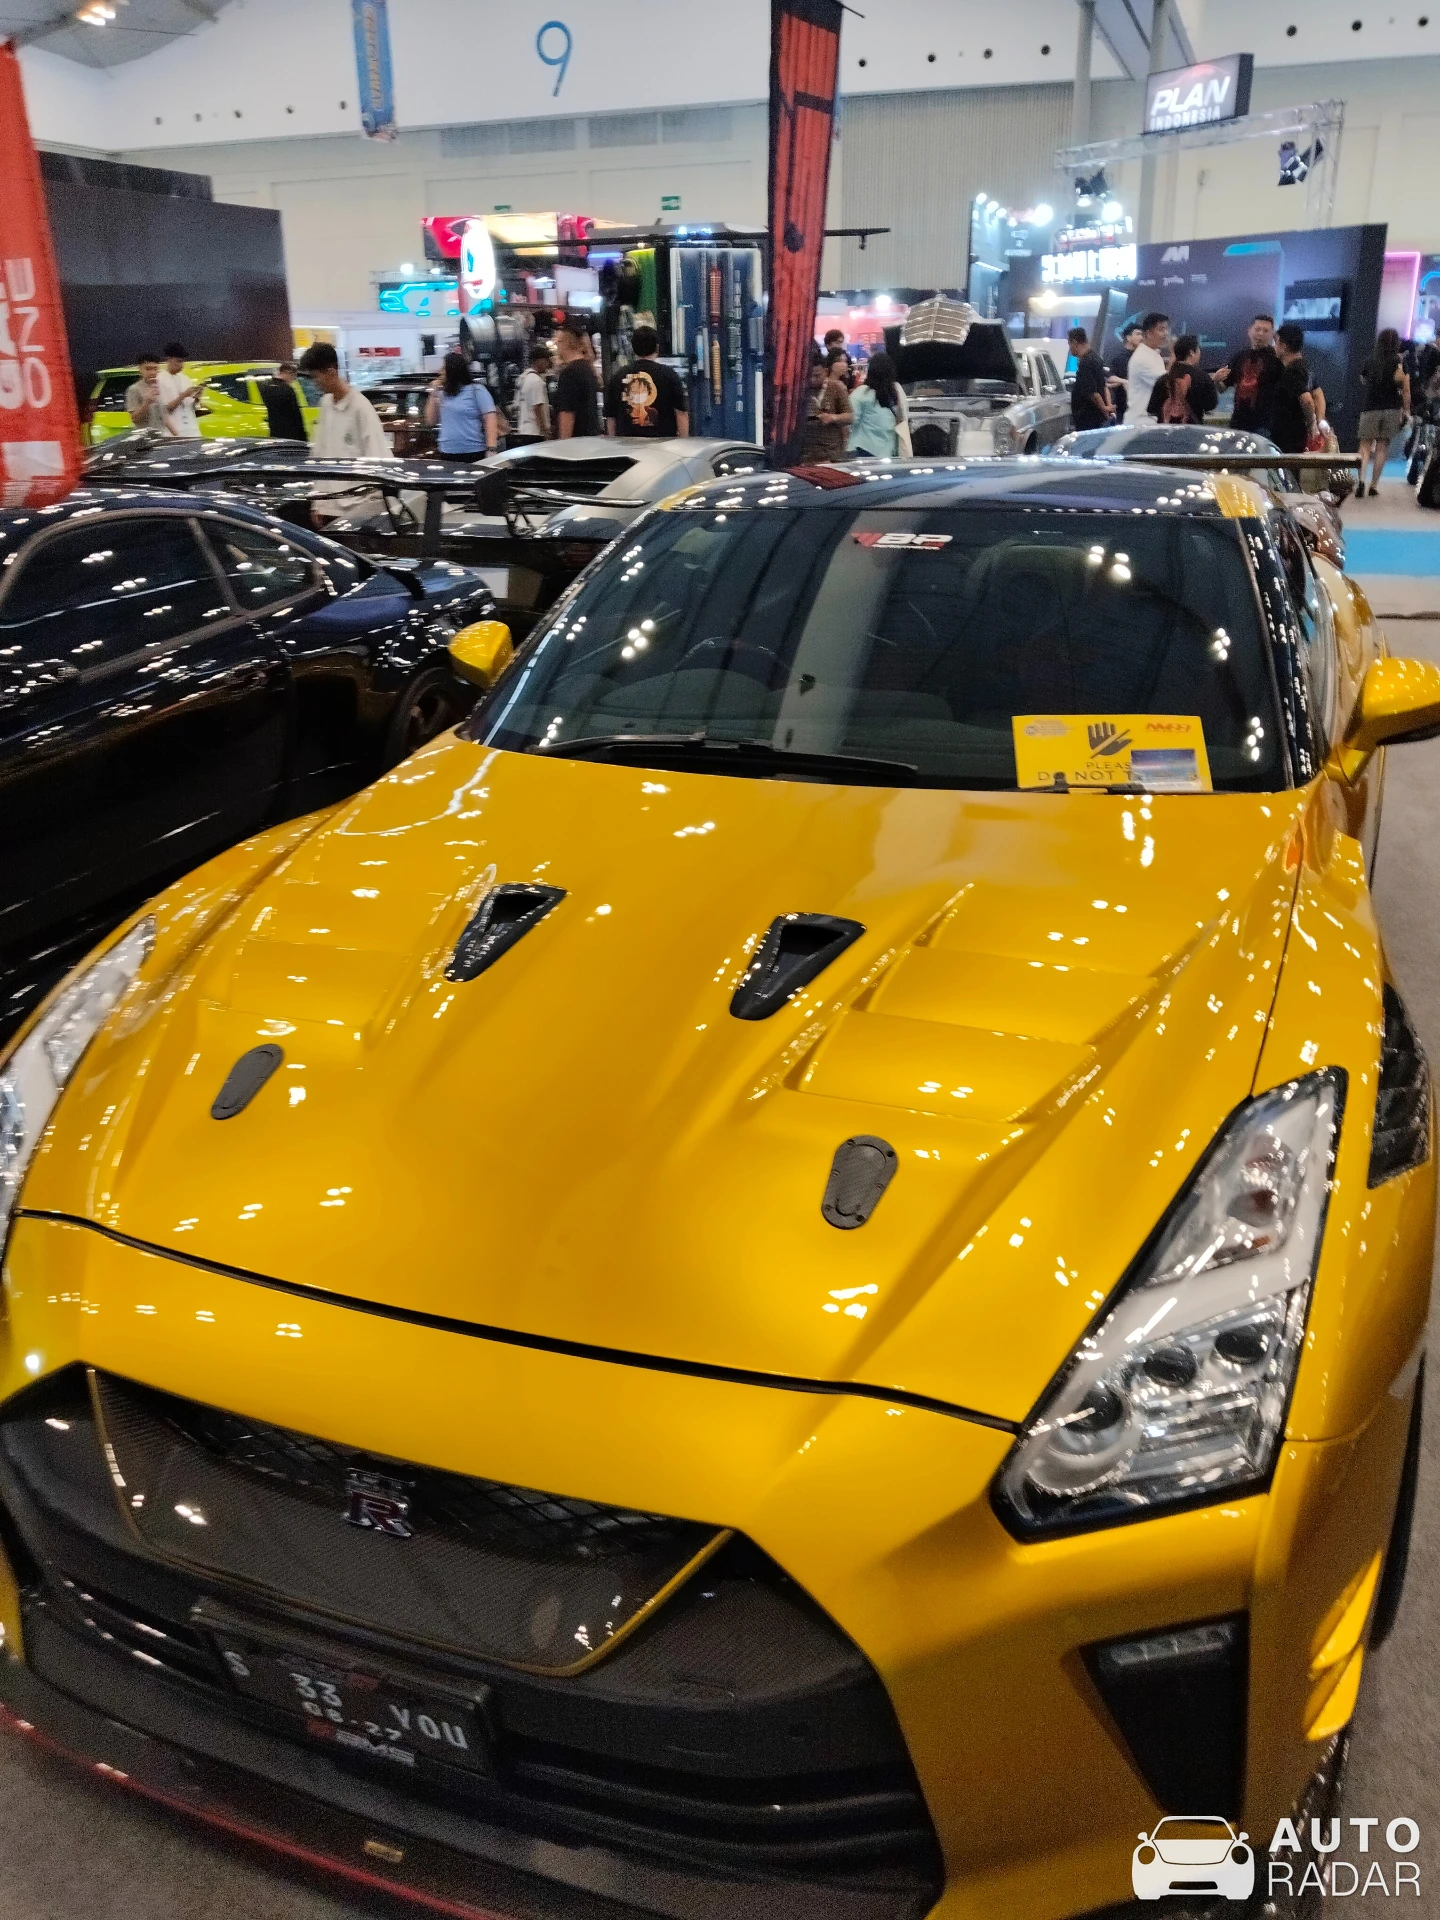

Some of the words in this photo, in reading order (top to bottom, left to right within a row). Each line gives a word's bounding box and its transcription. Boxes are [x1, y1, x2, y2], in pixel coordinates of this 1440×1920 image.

[537, 20, 572, 97] 9
[1150, 76, 1230, 116] PLAN
[1149, 105, 1221, 131] INDONESIA
[1074, 770, 1115, 781] NOT
[1086, 761, 1132, 770] PLEAS
